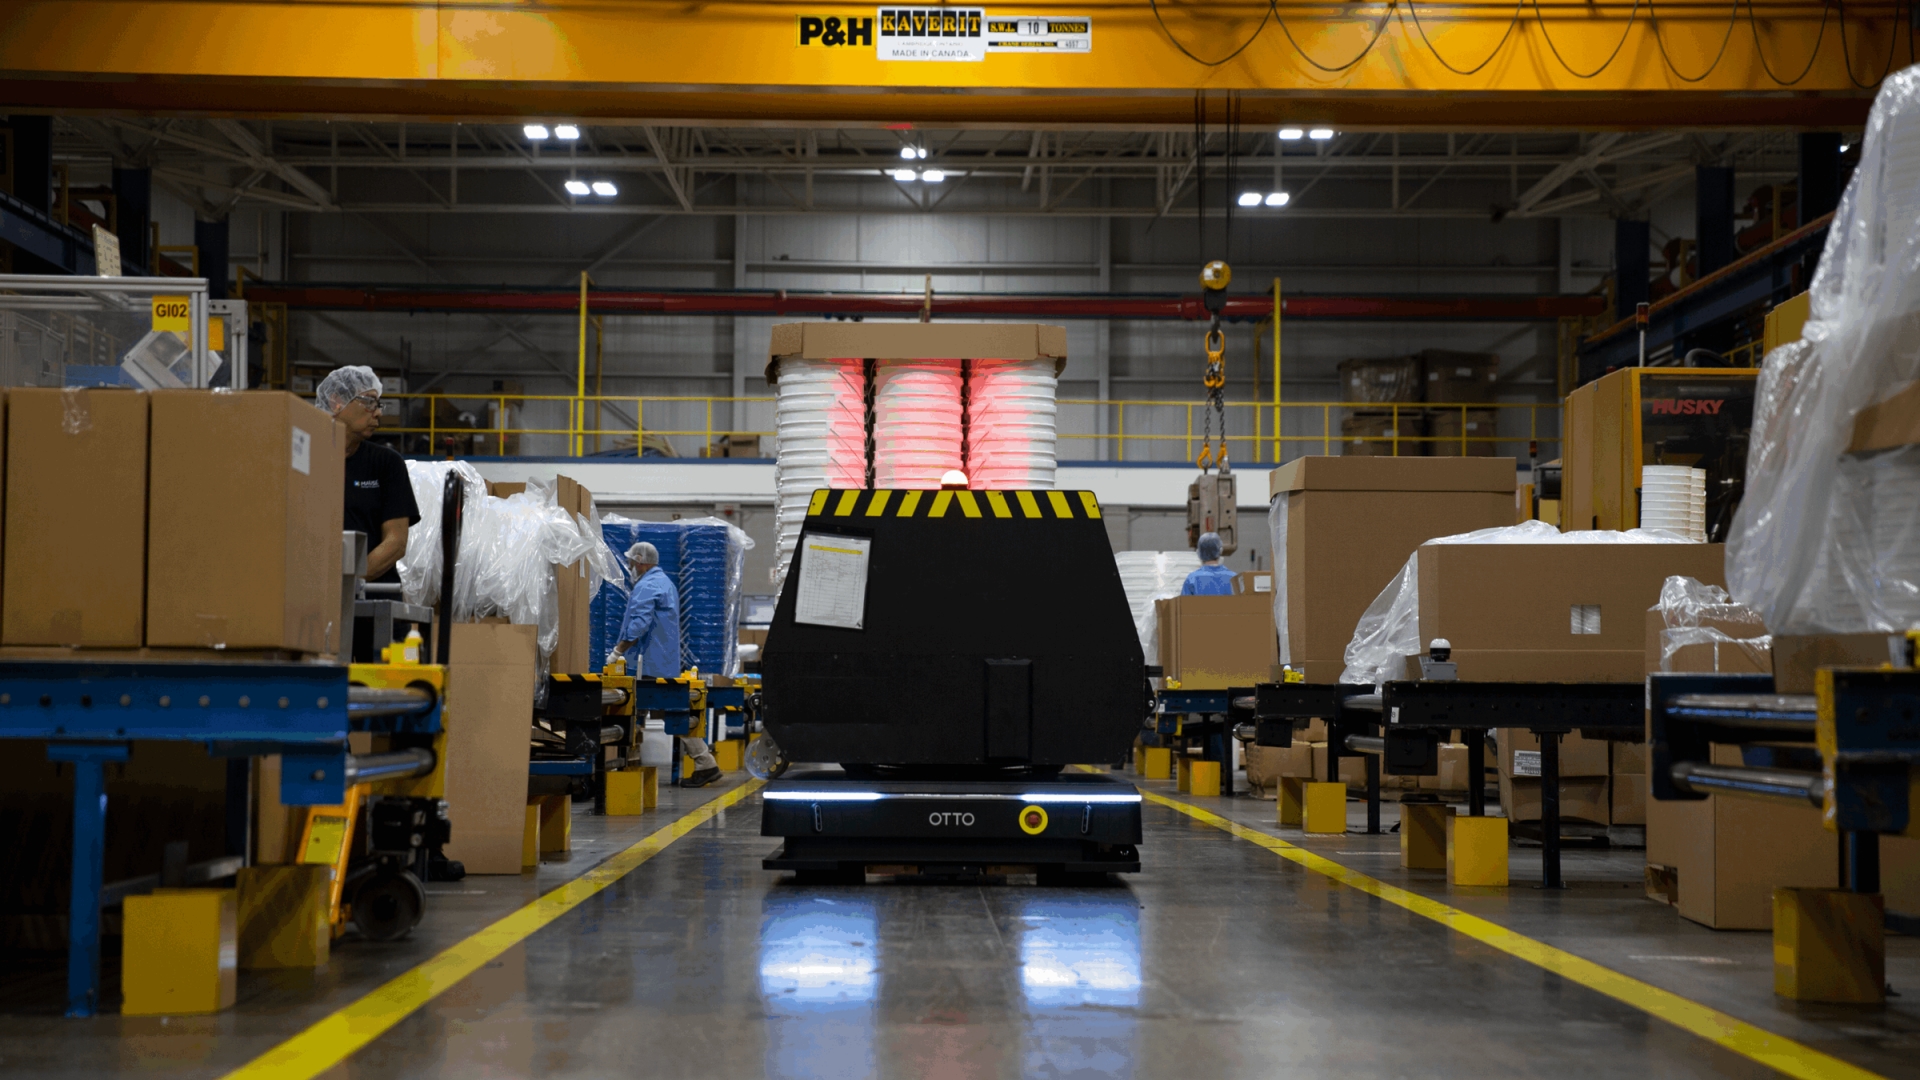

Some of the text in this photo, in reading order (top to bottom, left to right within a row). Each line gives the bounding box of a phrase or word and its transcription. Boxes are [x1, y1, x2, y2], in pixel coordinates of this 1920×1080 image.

[881, 14, 981, 33] KAVERIT
[1027, 21, 1040, 35] 10
[1050, 22, 1086, 33] TONNES
[800, 17, 872, 46] P&H
[892, 49, 917, 57] MADE
[920, 49, 930, 57] IN
[156, 303, 187, 318] GI02
[1652, 399, 1724, 415] HUSKY
[929, 812, 975, 826] OTTO
